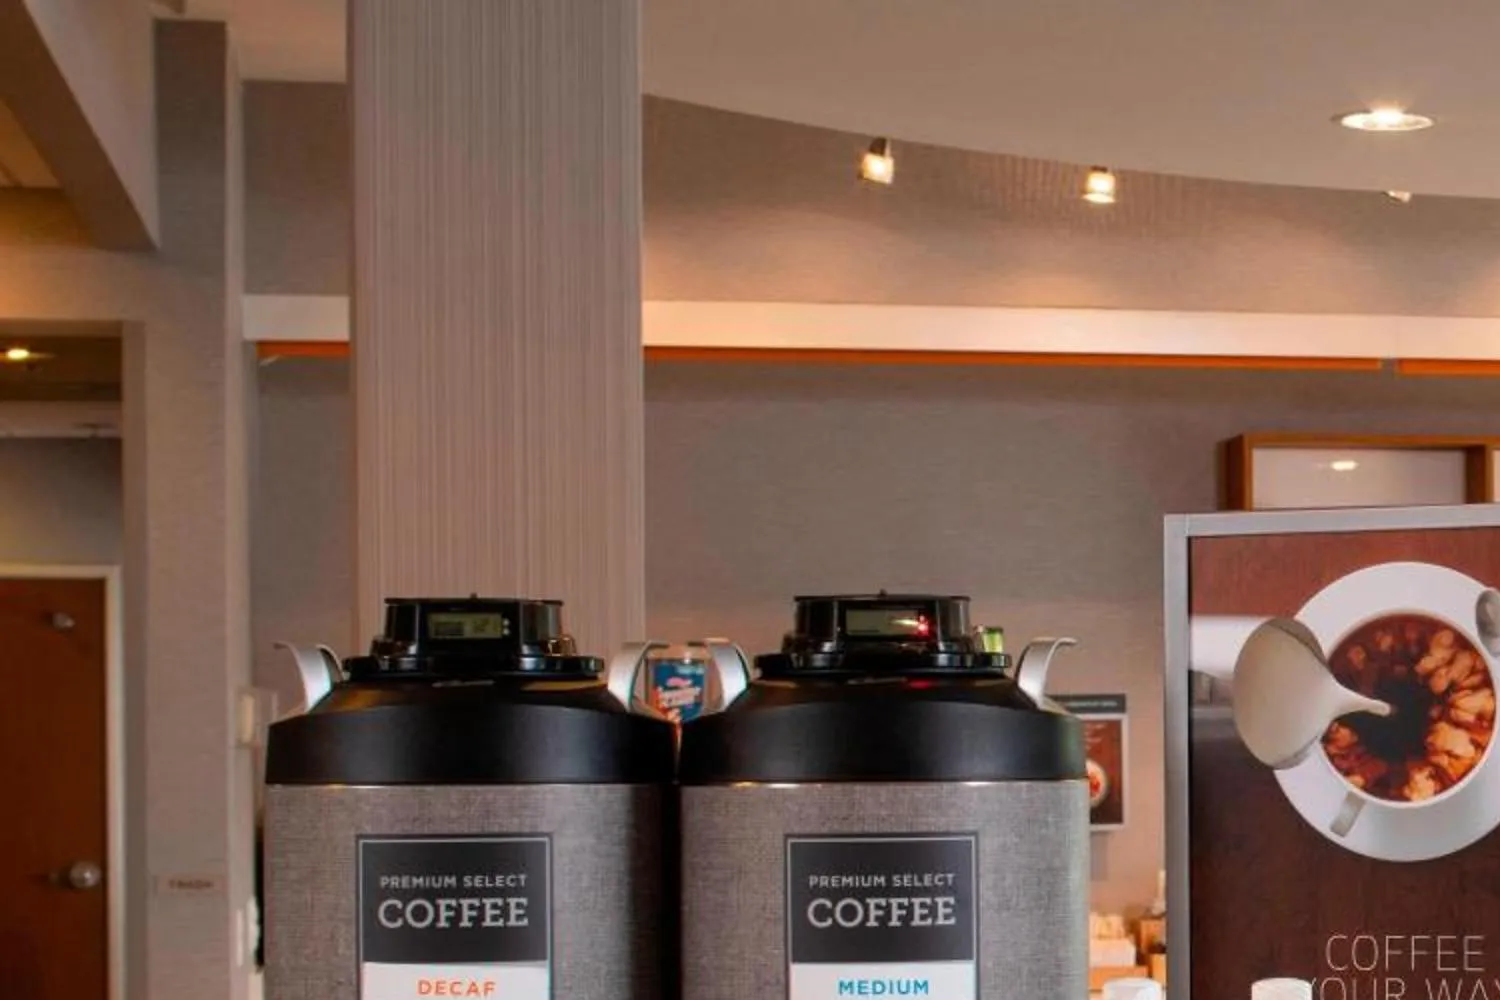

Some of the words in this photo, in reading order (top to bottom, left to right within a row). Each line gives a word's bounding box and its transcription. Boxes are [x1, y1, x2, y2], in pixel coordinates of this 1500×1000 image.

[380, 875, 457, 889] PREMIUM
[463, 874, 528, 888] SELECT
[809, 875, 886, 888] PREMIUM
[892, 873, 956, 887] SELECT
[378, 897, 529, 929] COFFEE
[807, 896, 956, 928] COFFEE
[1325, 934, 1485, 972] COFFEE
[418, 979, 496, 997] DECAF
[838, 979, 929, 996] MEDIUM
